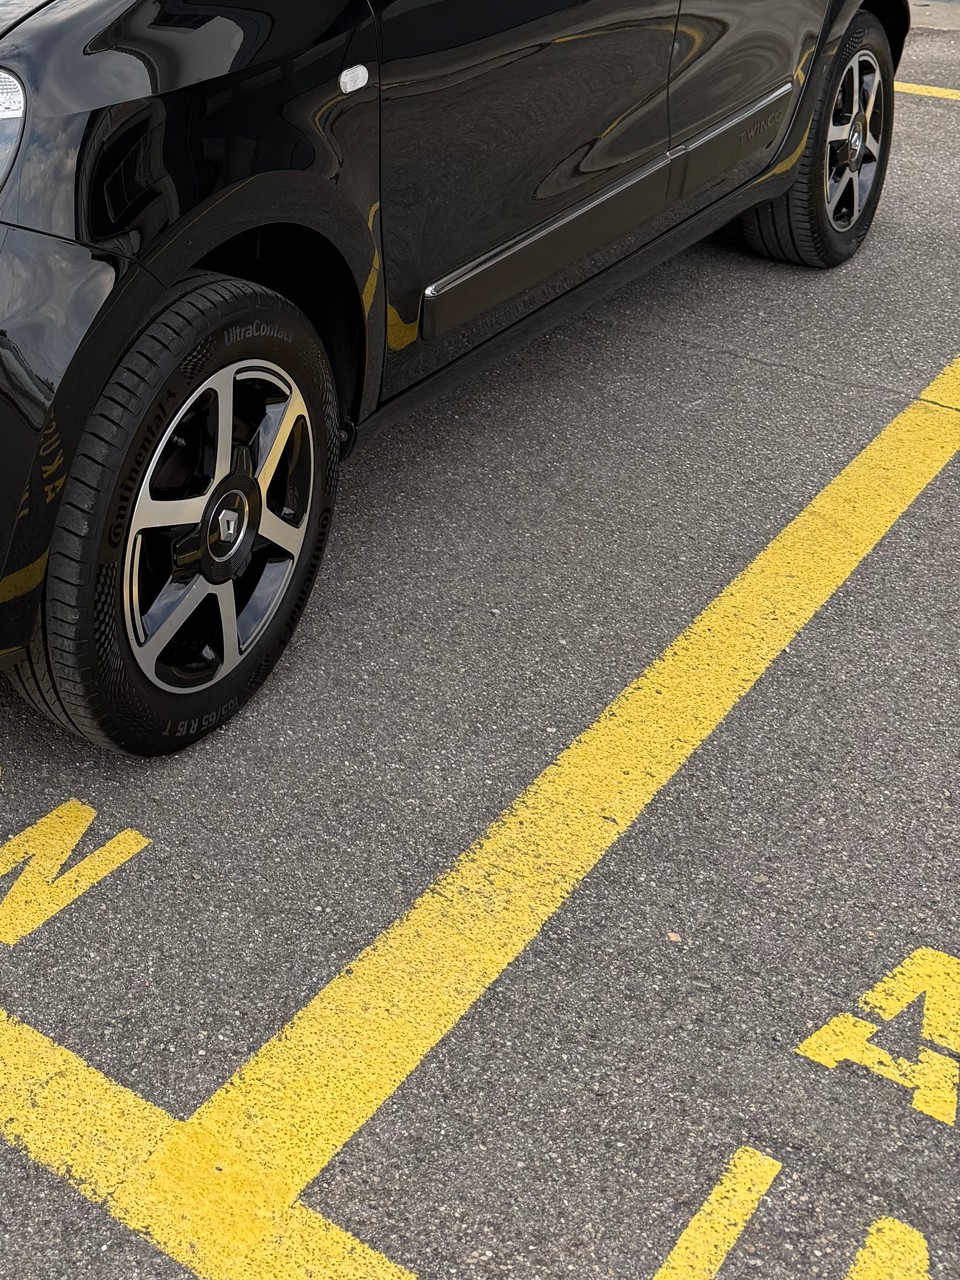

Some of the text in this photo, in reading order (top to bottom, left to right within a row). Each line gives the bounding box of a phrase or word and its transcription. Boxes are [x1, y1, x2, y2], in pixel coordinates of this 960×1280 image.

[737, 109, 782, 146] TWINGO
[223, 320, 293, 346] UltraContact
[108, 402, 168, 550] Continental
